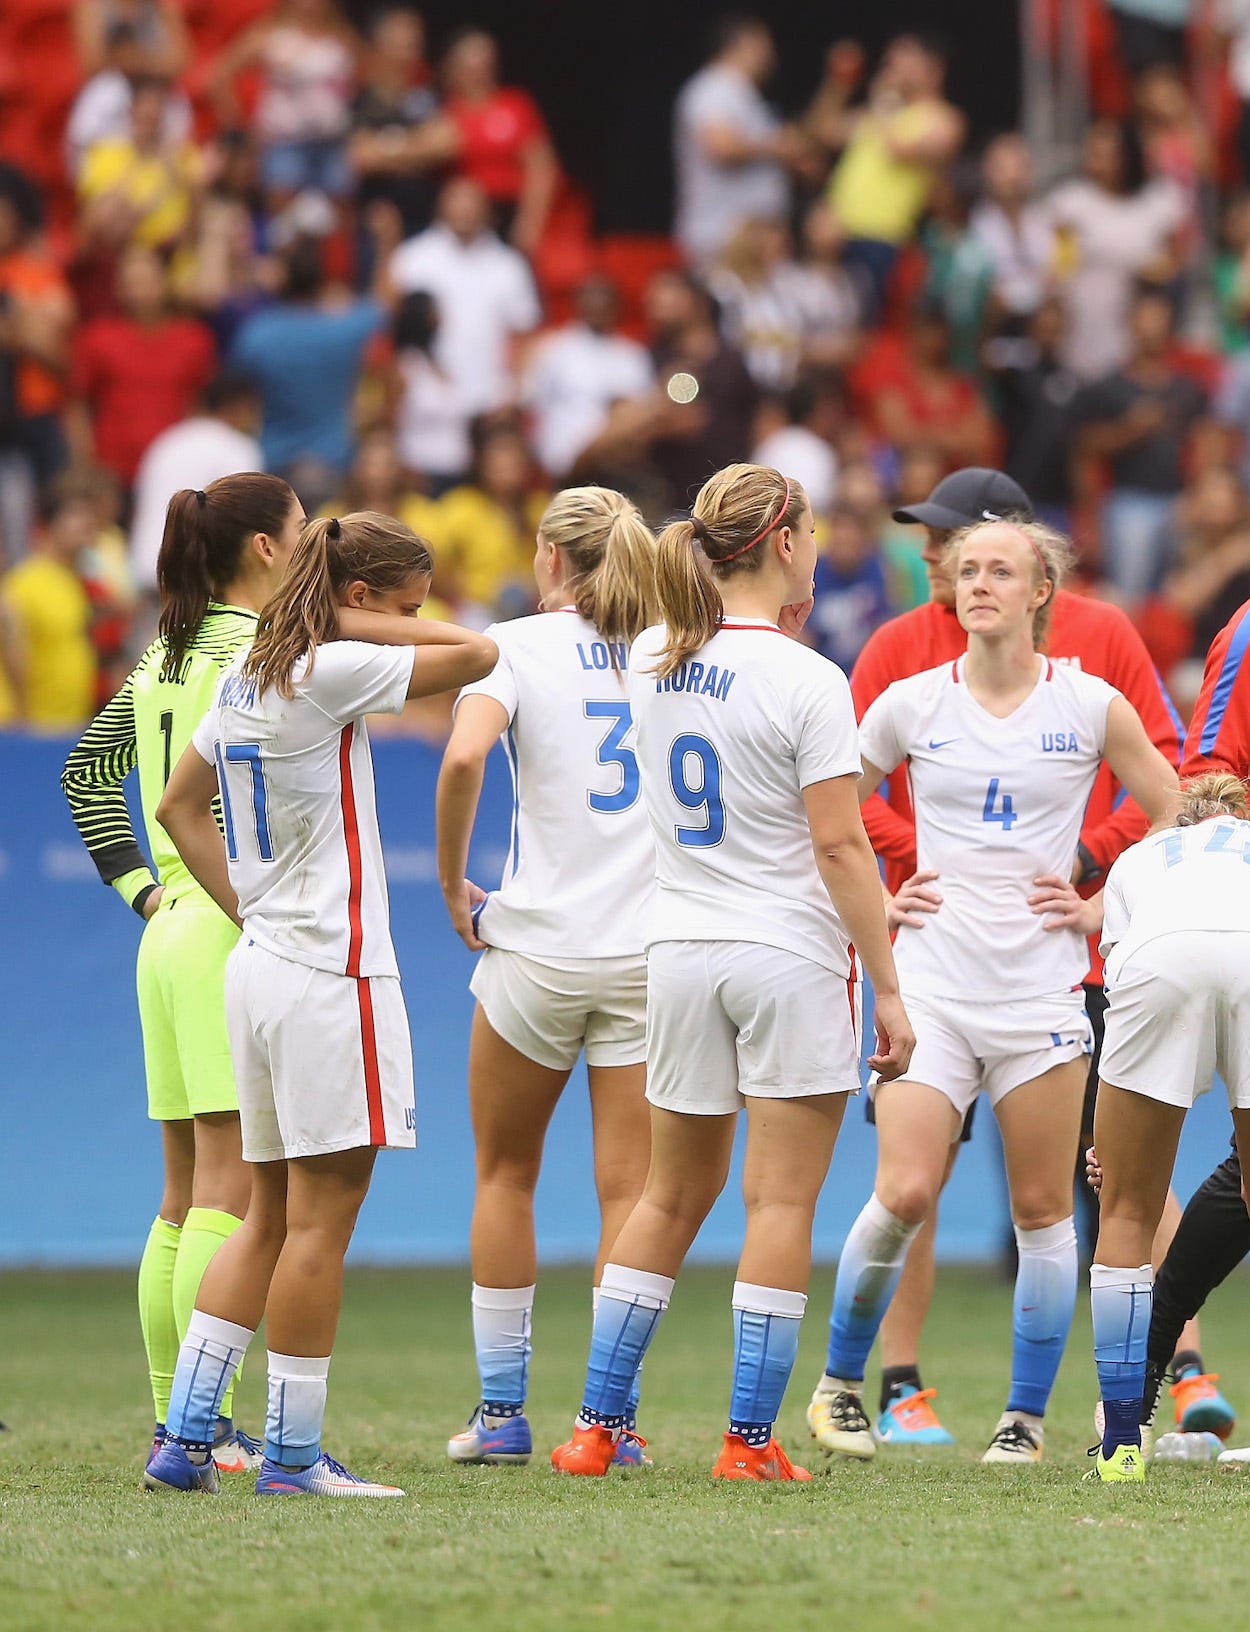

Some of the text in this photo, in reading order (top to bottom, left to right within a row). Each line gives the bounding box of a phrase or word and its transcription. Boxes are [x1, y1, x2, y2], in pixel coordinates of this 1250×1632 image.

[214, 739, 275, 862] 17
[583, 699, 642, 815] 3
[667, 732, 727, 849] 9
[1042, 733, 1079, 753] USA
[983, 778, 1018, 831] 4
